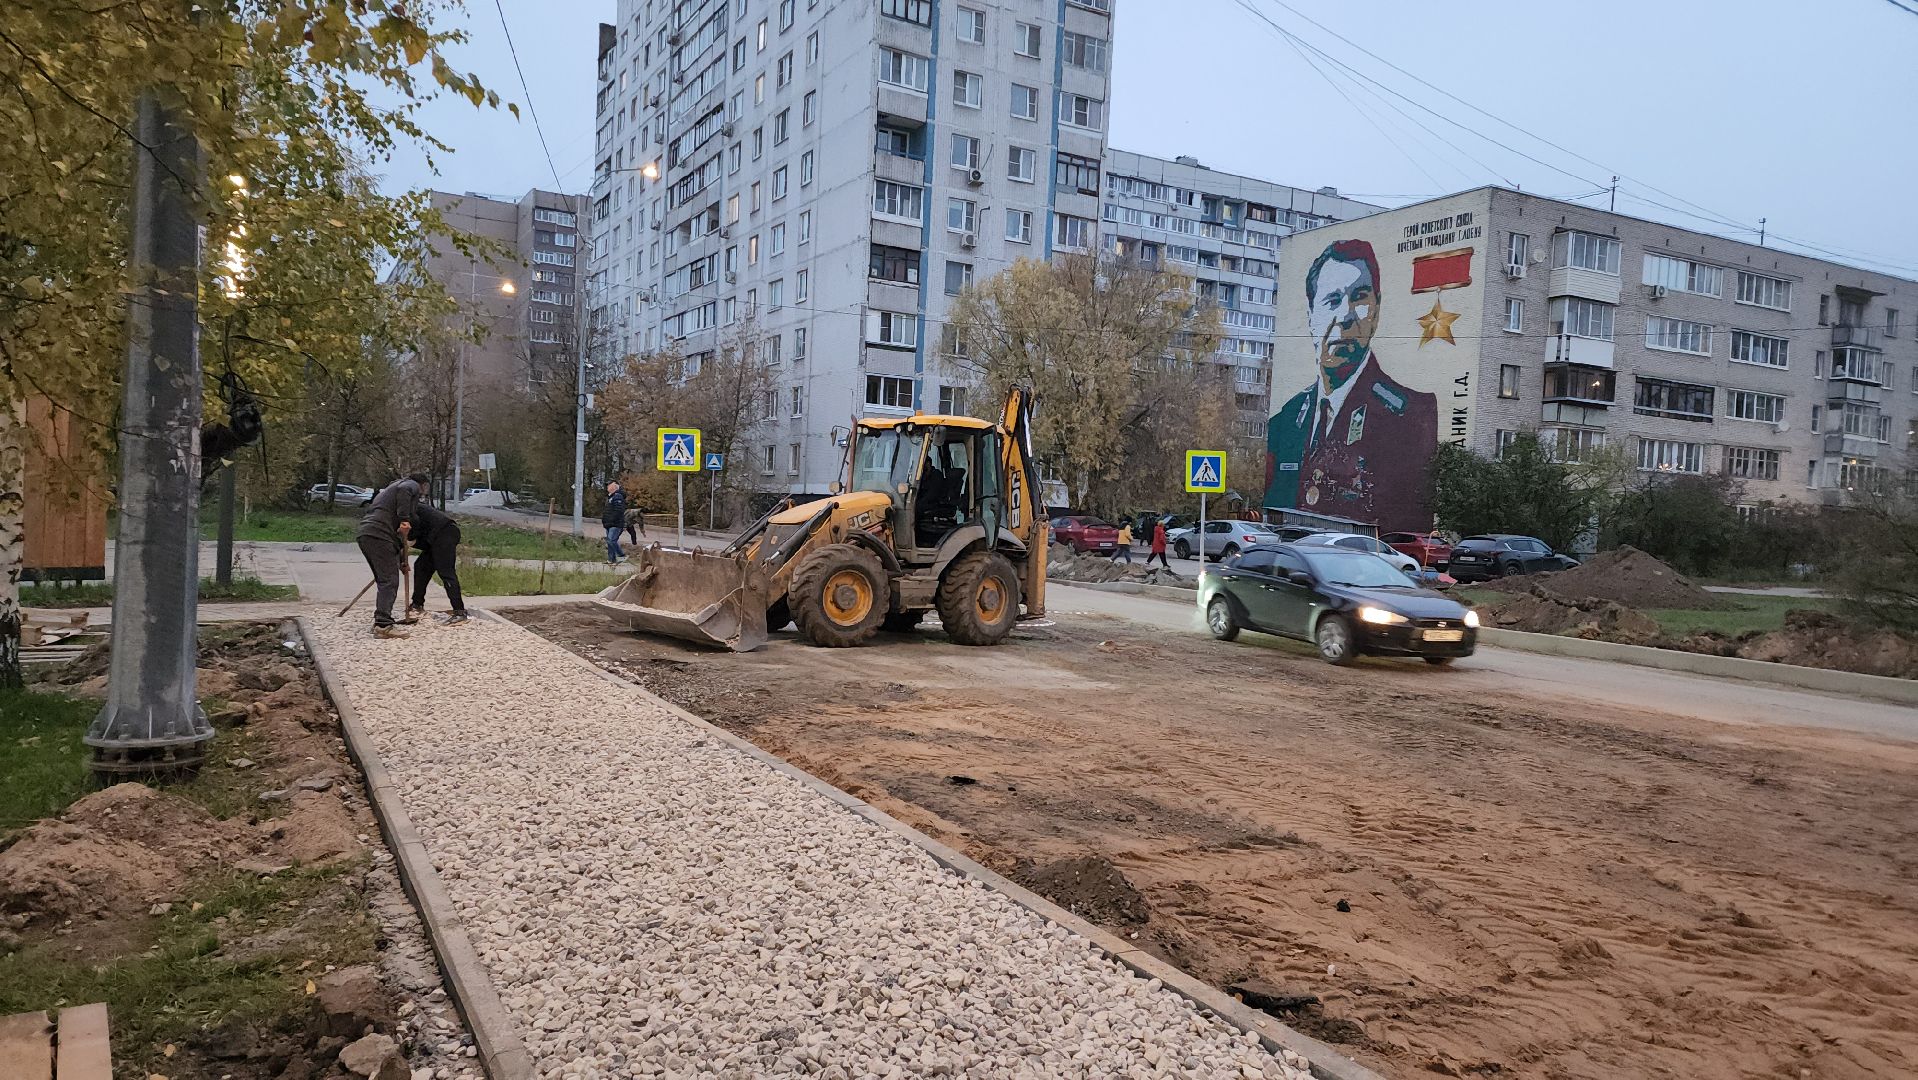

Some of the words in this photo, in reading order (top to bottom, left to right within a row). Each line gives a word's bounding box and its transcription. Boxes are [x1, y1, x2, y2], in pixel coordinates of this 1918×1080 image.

[1404, 223, 1418, 238] ГЕРОЙ
[1451, 407, 1468, 448] ДНИК
[1011, 471, 1021, 529] JCB
